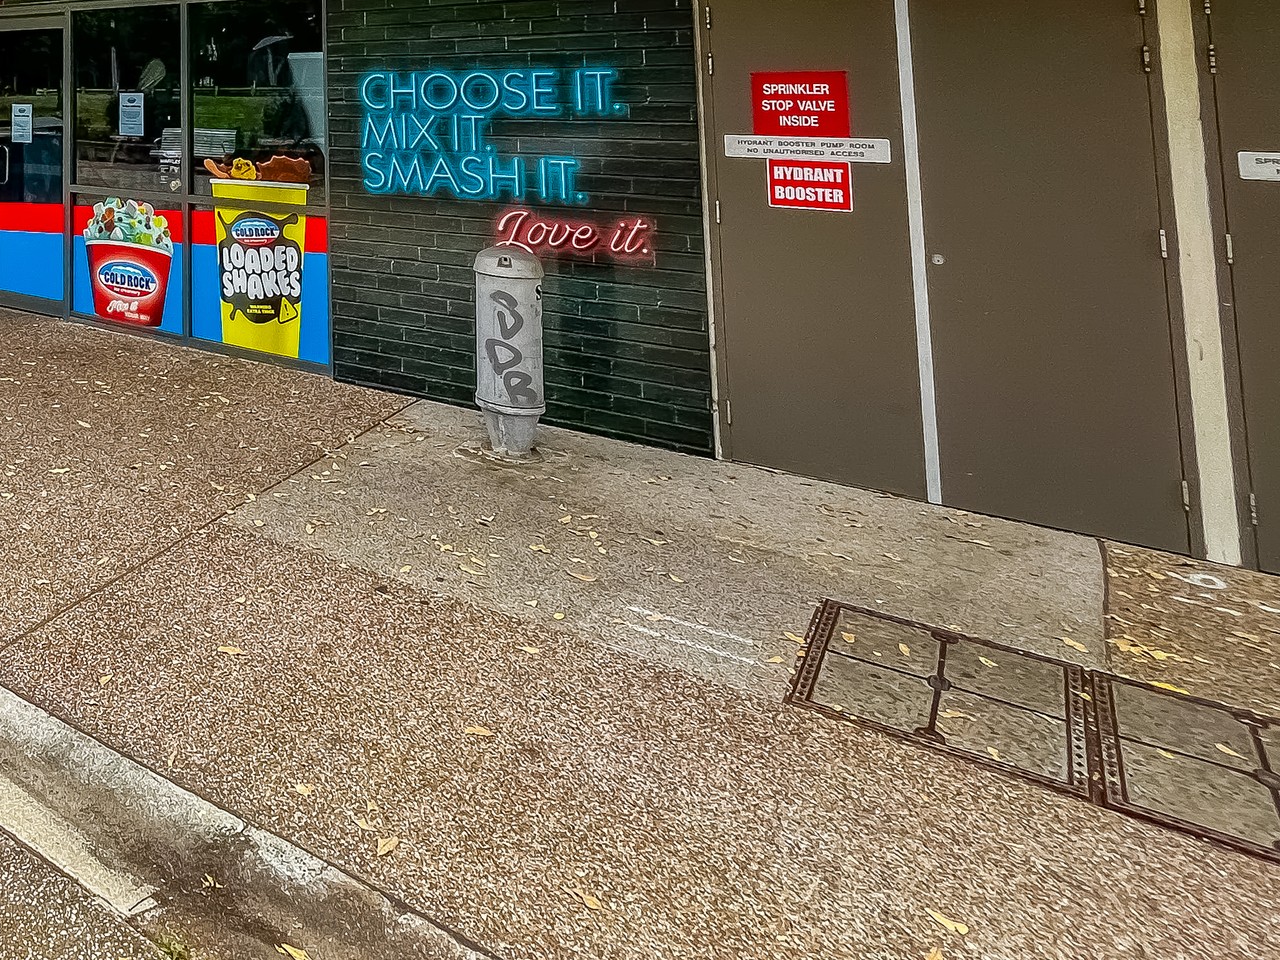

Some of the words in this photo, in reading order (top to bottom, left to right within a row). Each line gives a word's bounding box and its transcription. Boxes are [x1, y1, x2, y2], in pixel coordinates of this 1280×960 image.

[361, 72, 557, 110] CHOOSE
[574, 71, 621, 111] IT.
[762, 83, 830, 95] SPRINKLER
[761, 100, 793, 111] STOP
[797, 100, 836, 112] VALVE
[779, 115, 819, 127] INSIDE
[362, 113, 439, 151] MIX
[453, 114, 492, 152] IT.
[763, 148, 825, 156] UNAUTHORISED
[362, 152, 521, 197] SMASH
[540, 157, 585, 200] IT.
[773, 166, 844, 183] HYDRANT
[774, 185, 844, 203] BOOSTER
[235, 227, 254, 237] COLD
[254, 227, 276, 237] ROCK
[495, 210, 596, 254] Love
[610, 218, 650, 254] it.
[222, 243, 299, 274] LOADED
[104, 271, 126, 287] COLD
[127, 274, 151, 290] ROCK
[222, 269, 301, 300] SHAKES
